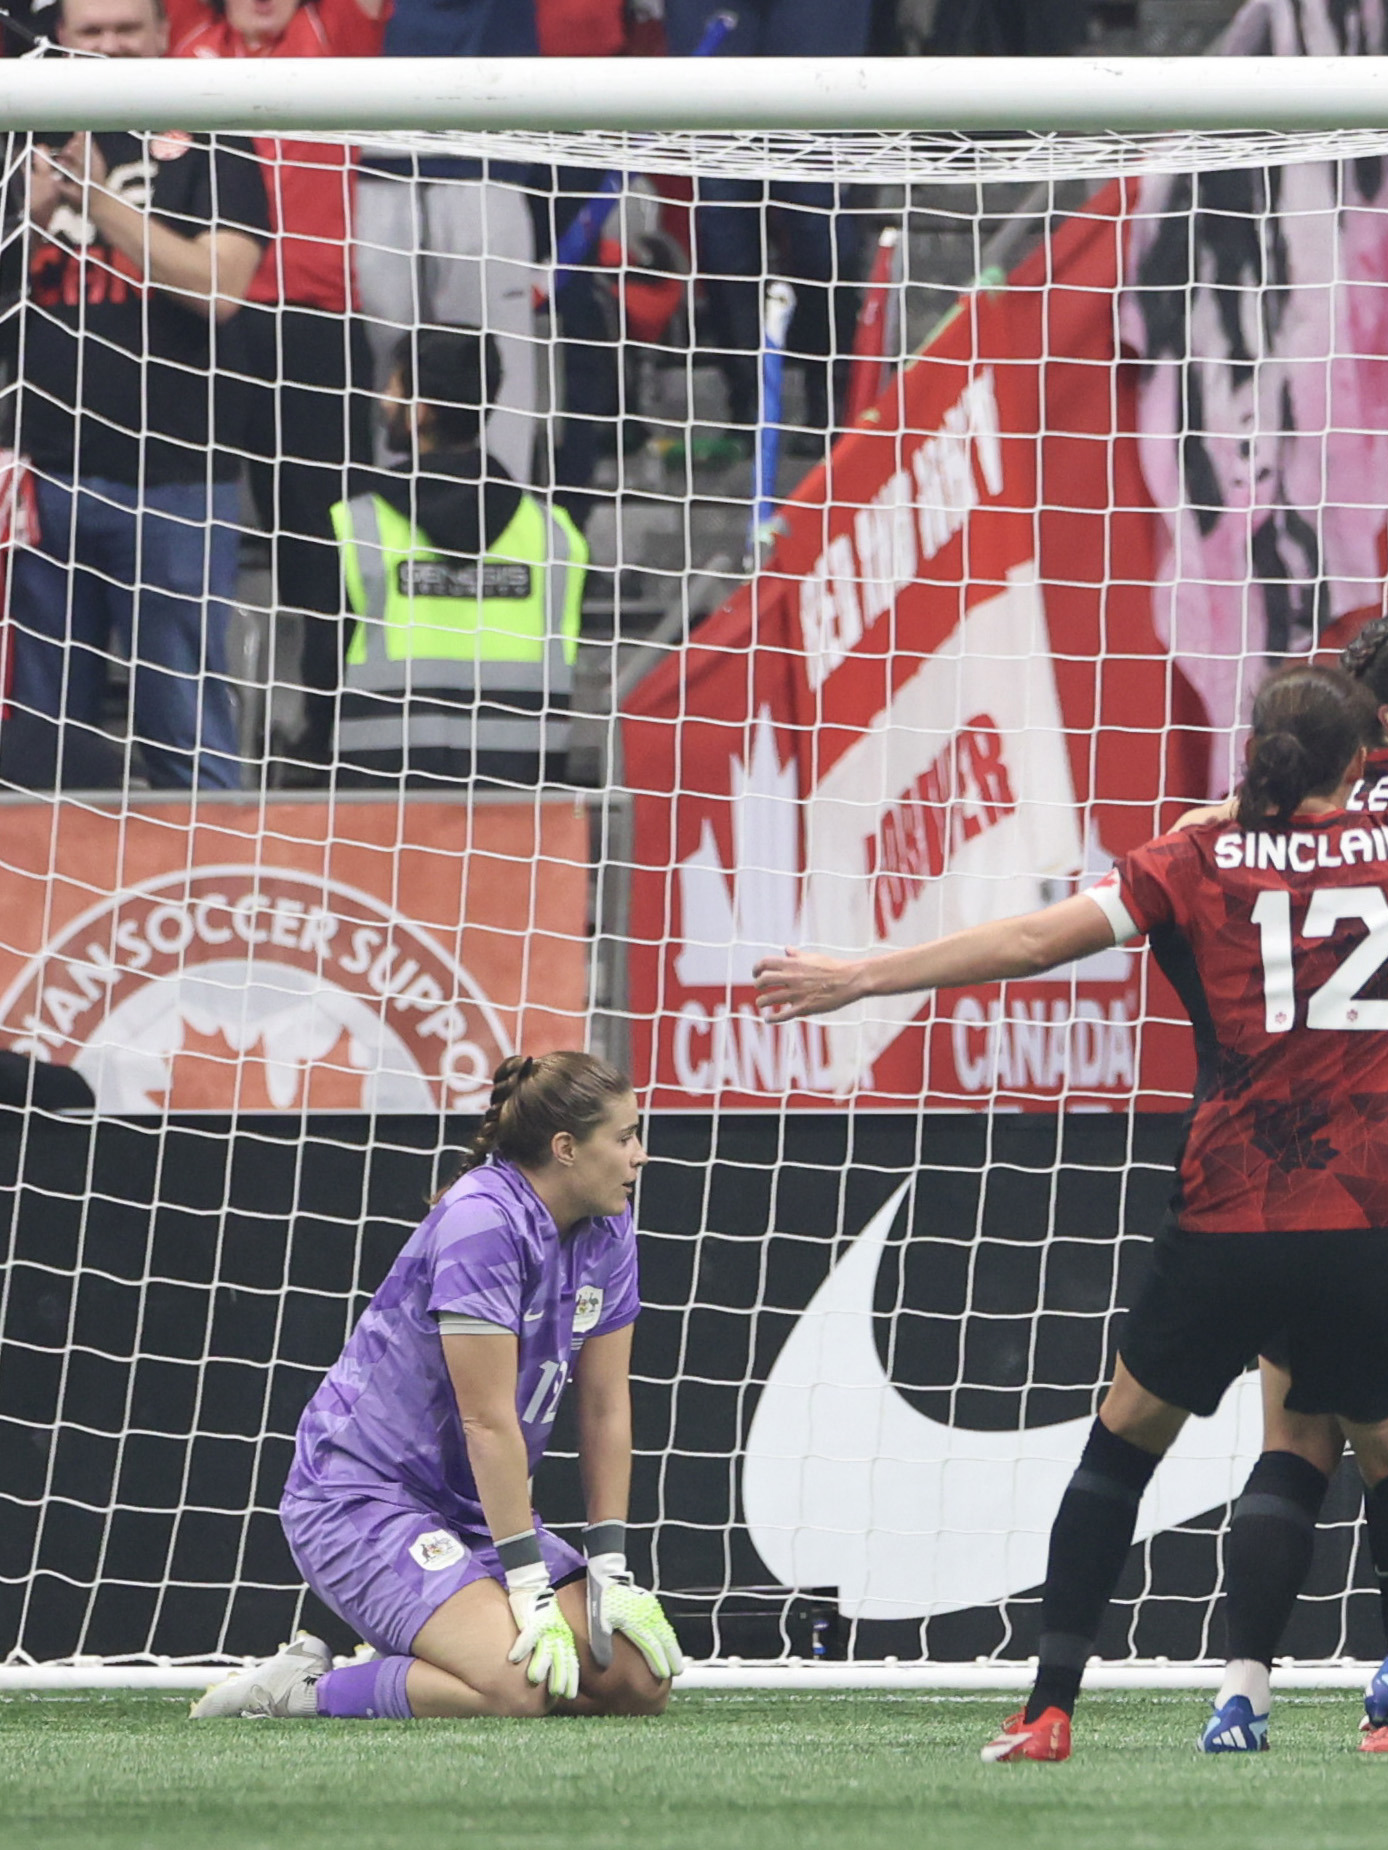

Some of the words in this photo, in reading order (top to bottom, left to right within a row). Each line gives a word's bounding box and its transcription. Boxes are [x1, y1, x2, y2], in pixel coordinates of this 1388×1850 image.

[116, 893, 339, 970] SOCCER
[339, 928, 493, 1112] SUPPO
[951, 998, 1135, 1091] CANADA
